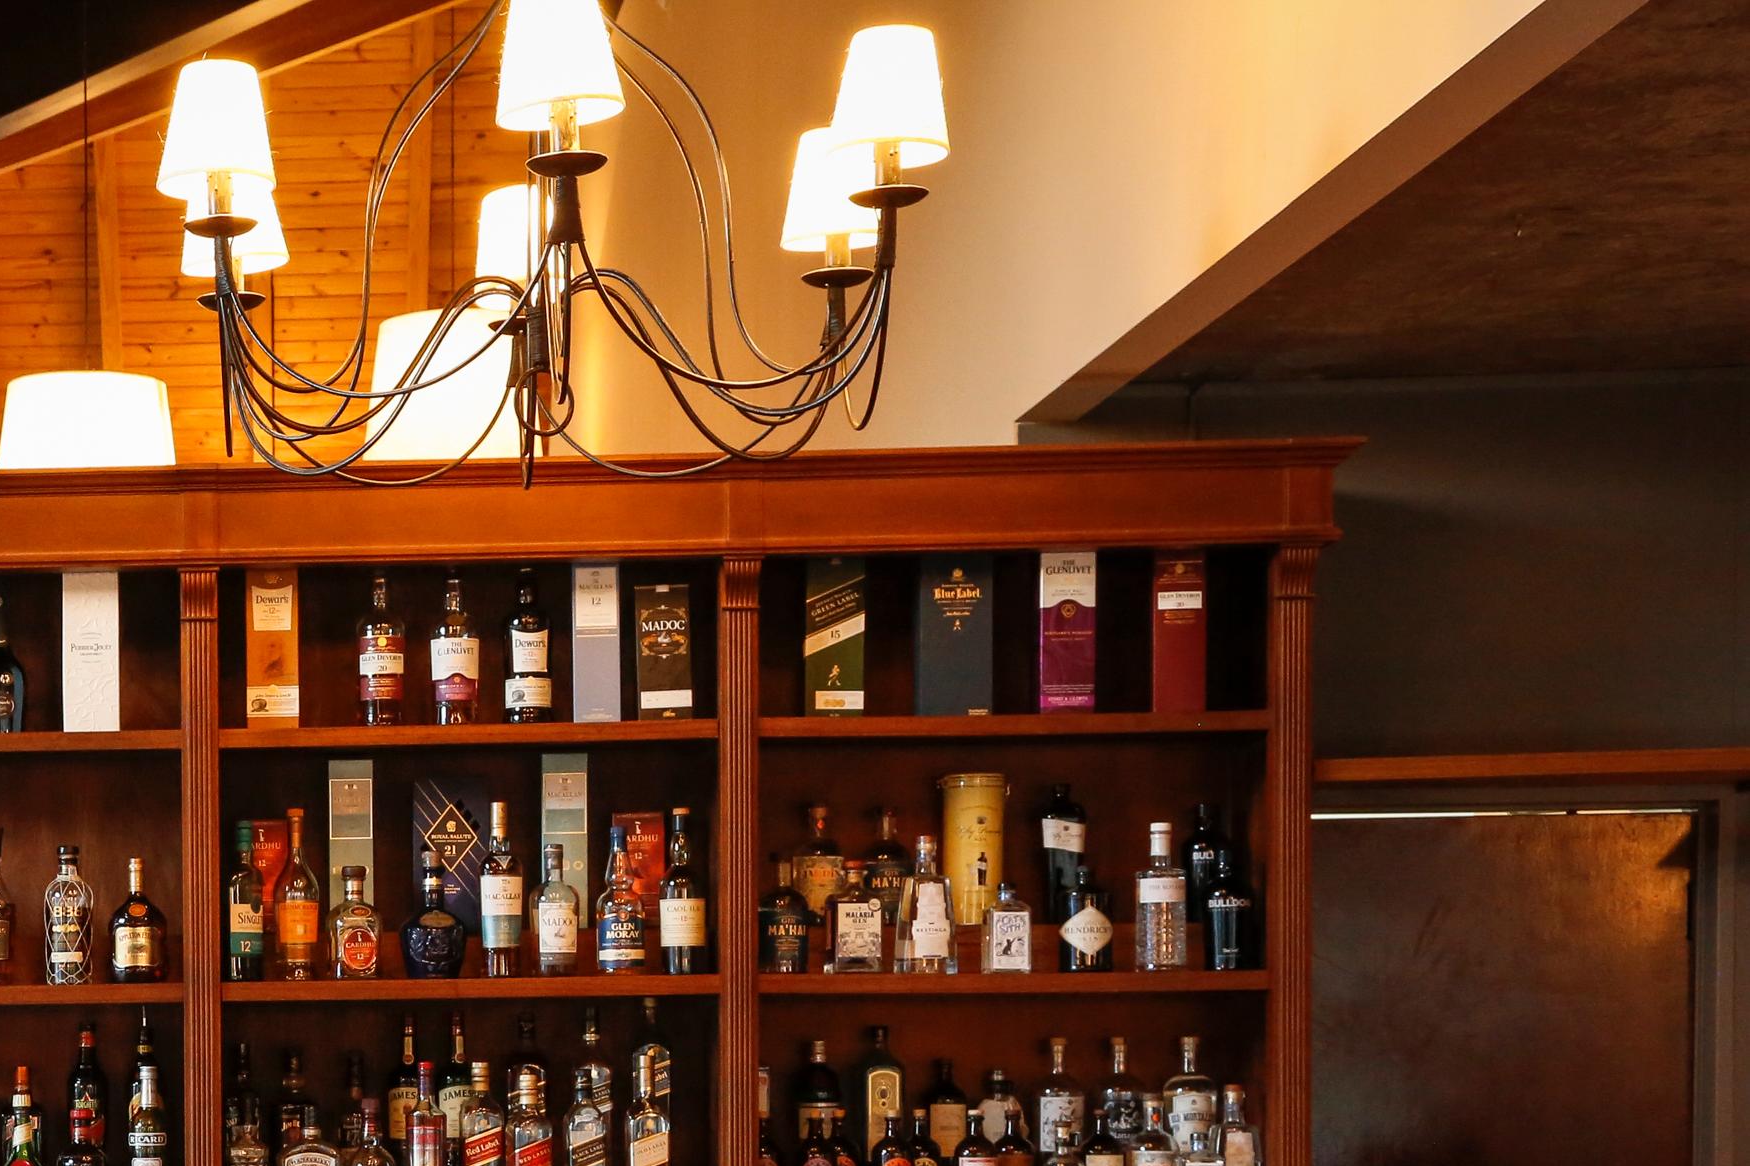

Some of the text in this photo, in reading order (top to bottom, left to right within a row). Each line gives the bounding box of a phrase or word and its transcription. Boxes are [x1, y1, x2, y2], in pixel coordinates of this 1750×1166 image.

[642, 620, 685, 632] MADOC
[444, 845, 456, 855] 21
[611, 922, 634, 930] GLEN
[606, 930, 640, 938] MORAY
[240, 940, 251, 952] 12
[466, 1139, 500, 1156] Red Label
